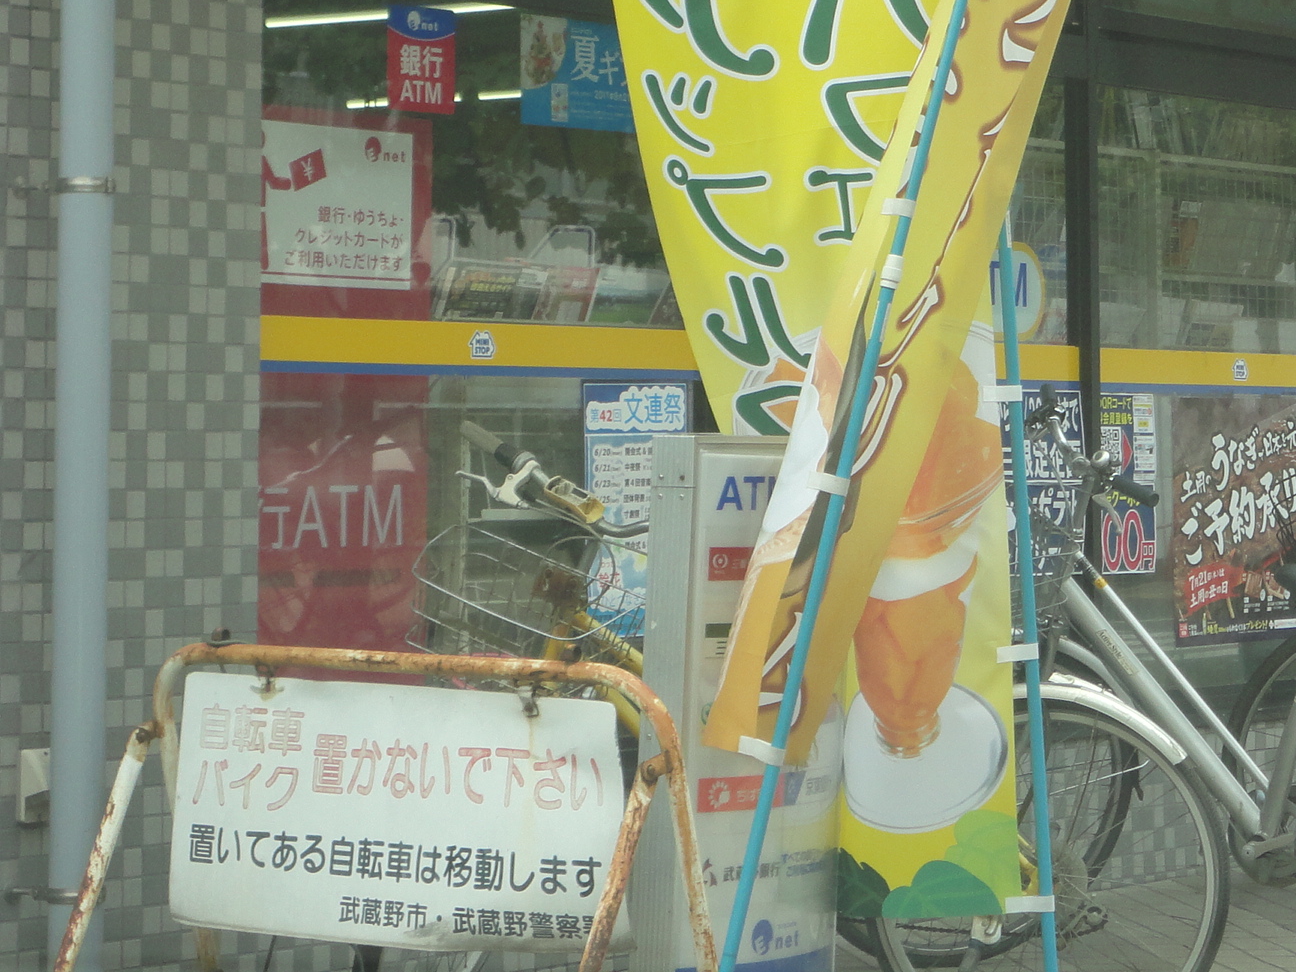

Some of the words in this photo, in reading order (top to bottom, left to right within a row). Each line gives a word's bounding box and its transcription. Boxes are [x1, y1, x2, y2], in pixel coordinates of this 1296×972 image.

[400, 44, 443, 78] 銀行
[400, 79, 442, 105] ATM
[285, 250, 403, 272] ご利用いただけます
[624, 393, 682, 424] 文連祭
[200, 703, 305, 757] 自転車
[192, 759, 299, 812] バイク
[312, 733, 604, 811] 置かないで下さい
[187, 822, 602, 898] 置いてある自転車は移動します
